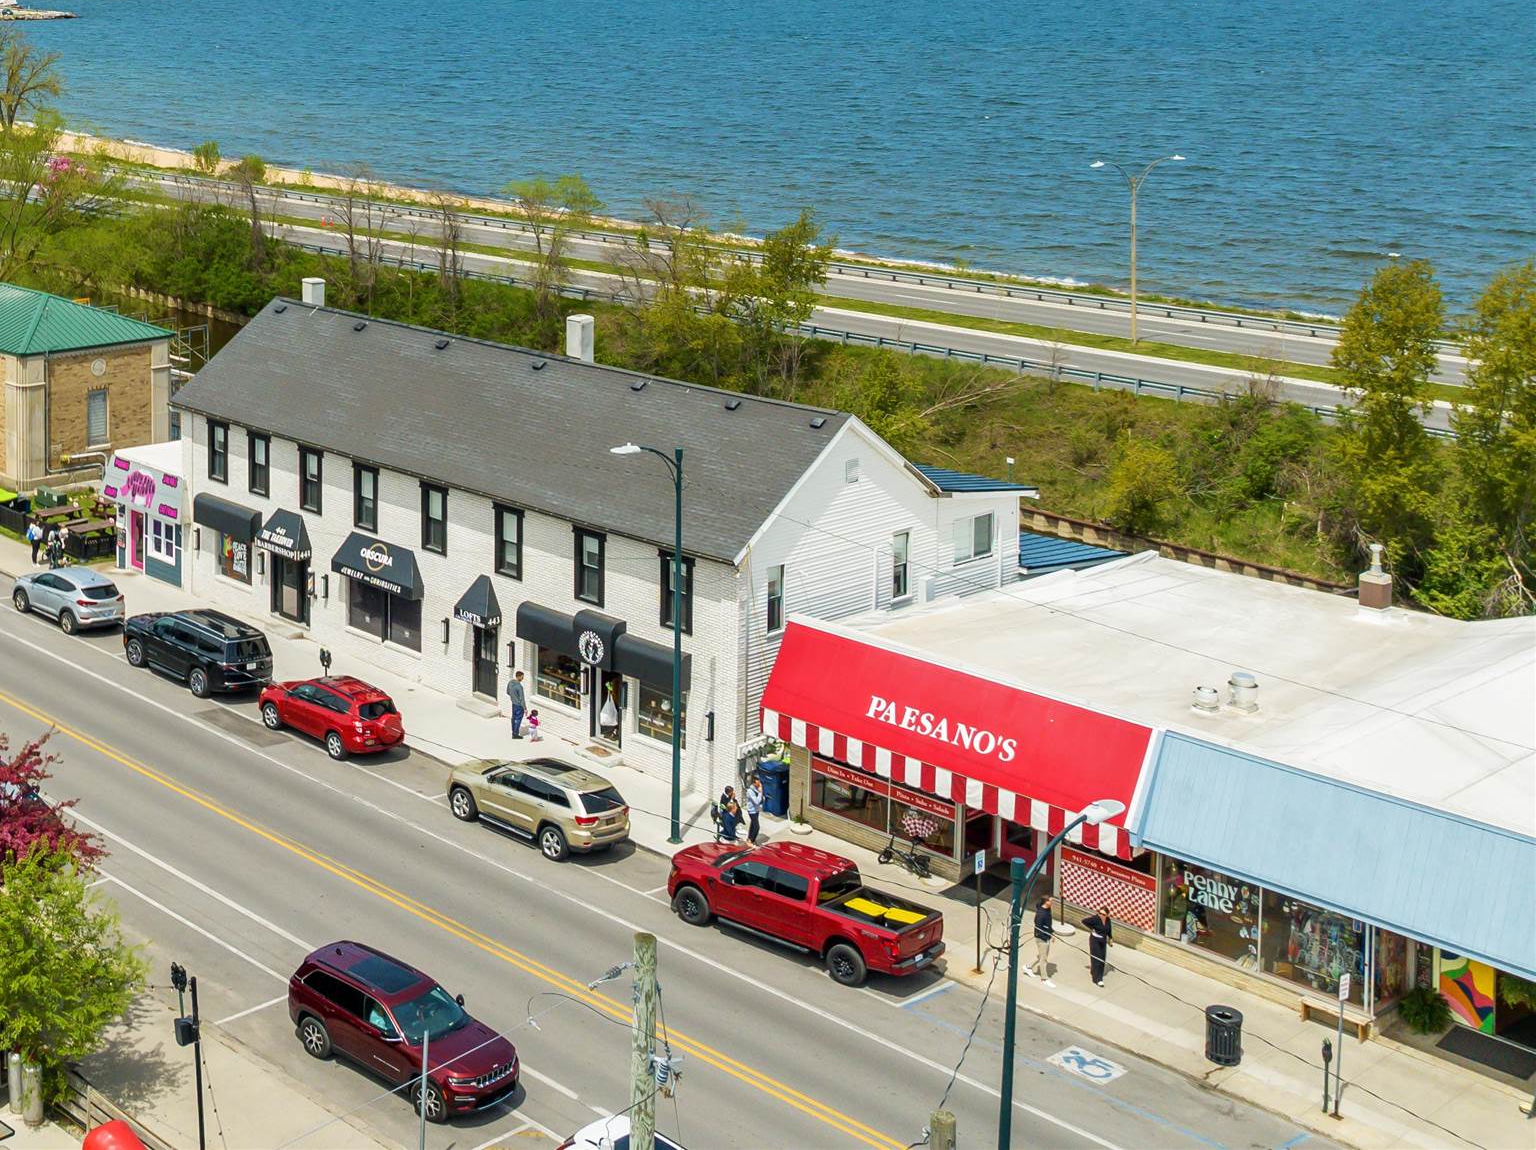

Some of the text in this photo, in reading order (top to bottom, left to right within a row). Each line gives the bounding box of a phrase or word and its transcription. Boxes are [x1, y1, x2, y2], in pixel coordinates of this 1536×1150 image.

[360, 548, 393, 567] OBSCURA
[459, 609, 481, 623] LOFTS
[865, 695, 1017, 762] PAESANO'S
